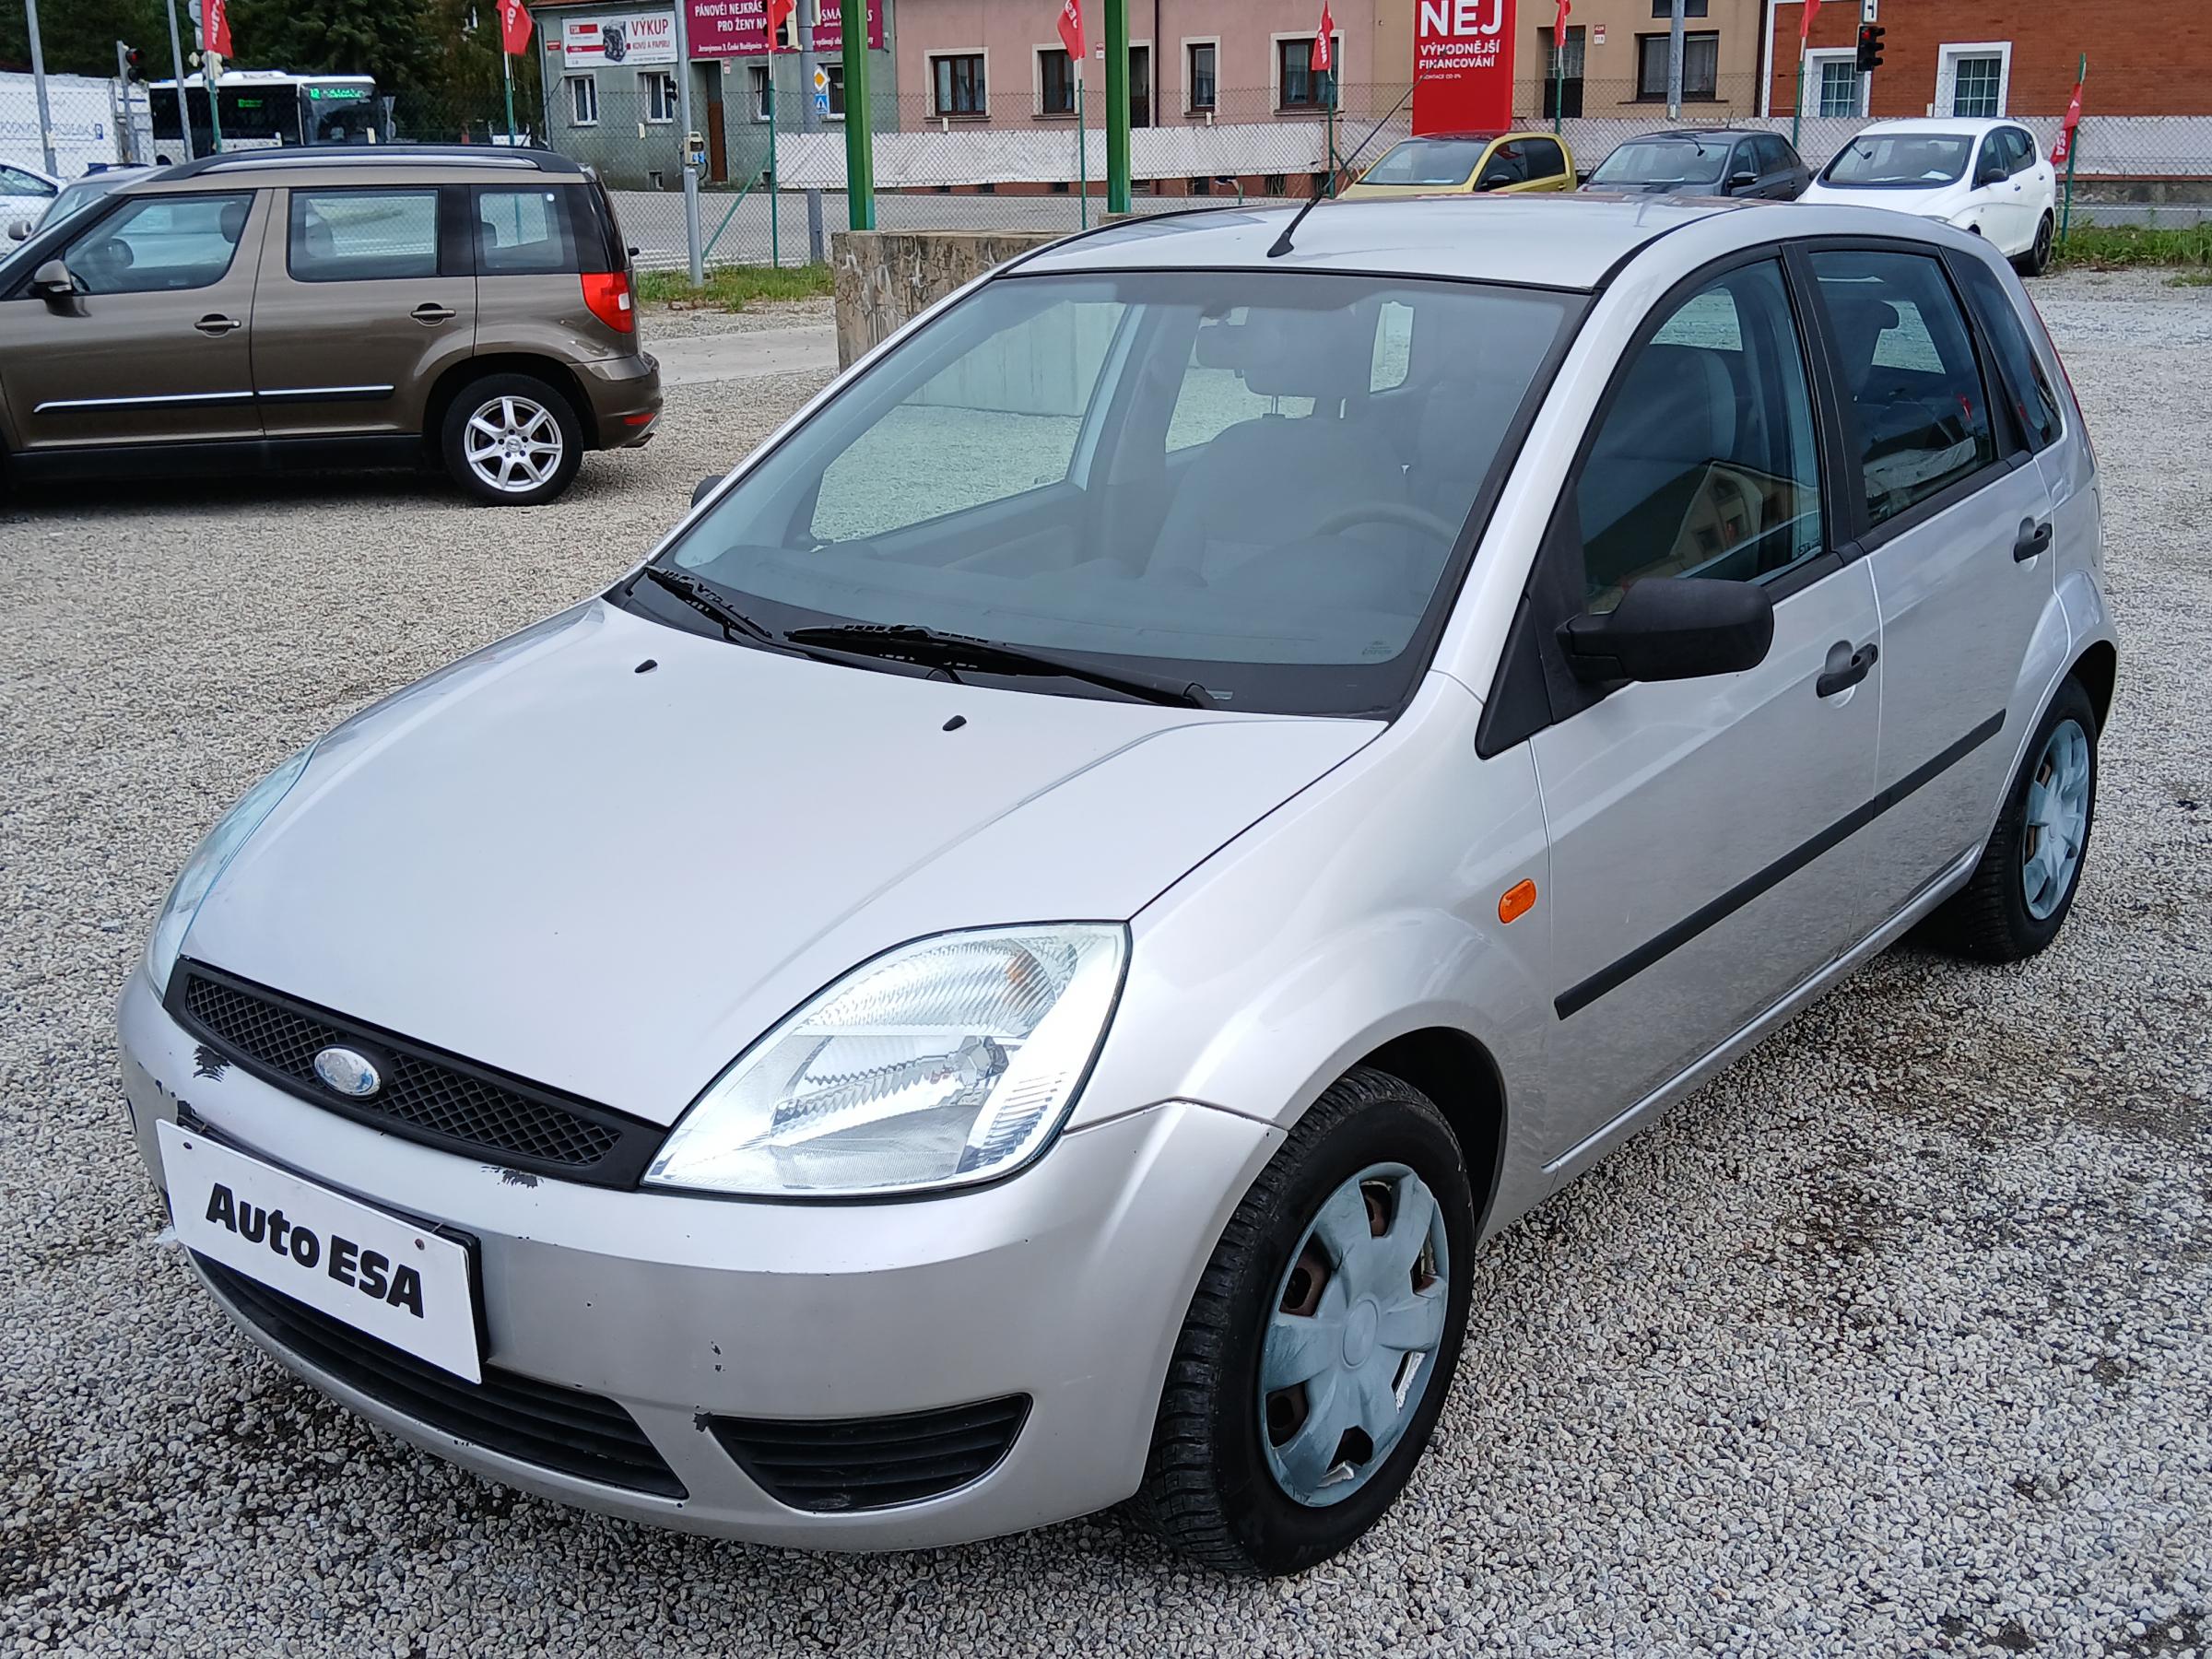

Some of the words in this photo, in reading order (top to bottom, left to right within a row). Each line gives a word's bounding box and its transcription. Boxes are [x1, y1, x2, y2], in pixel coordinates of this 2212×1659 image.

[729, 0, 763, 15] NEJKRÁS
[631, 17, 668, 36] VÝKUP
[717, 20, 733, 31] PRO
[735, 17, 756, 30] ŽENY
[1420, 0, 1502, 37] NEJ
[1420, 39, 1501, 56] VÝHODNĚJŠÍ
[1418, 55, 1495, 70] FINANCOVÁNÍ
[206, 1182, 321, 1268] Auto
[328, 1234, 424, 1319] ESA
